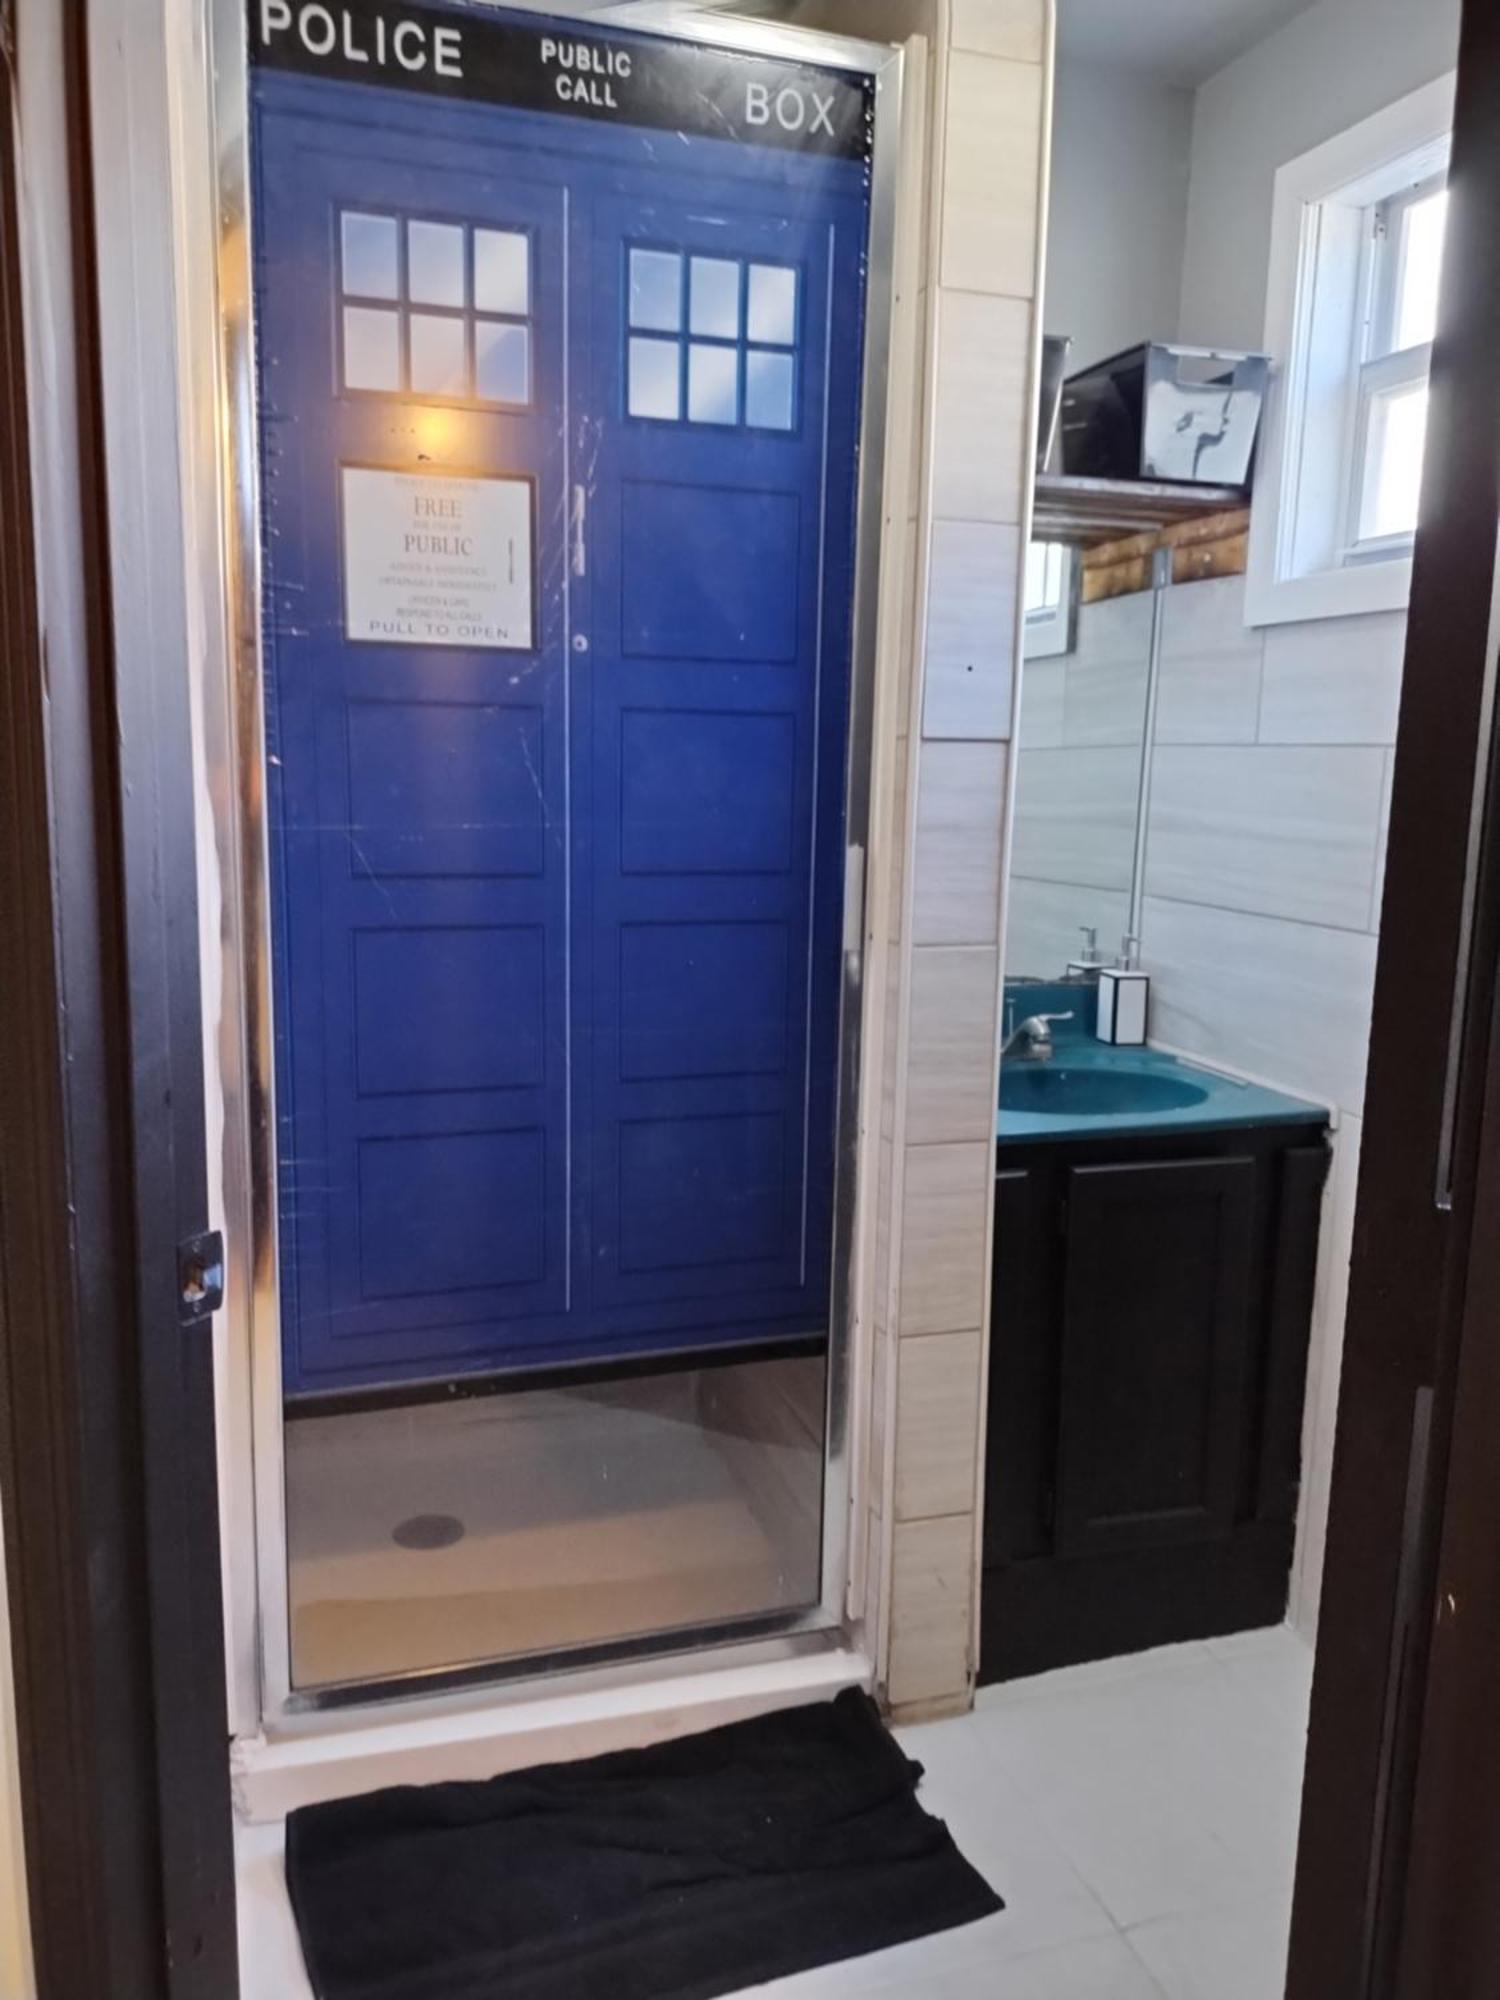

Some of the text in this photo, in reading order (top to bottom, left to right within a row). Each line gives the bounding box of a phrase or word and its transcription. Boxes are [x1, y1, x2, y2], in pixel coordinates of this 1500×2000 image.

[260, 0, 463, 78] POLICE
[540, 38, 632, 77] PUBLIC
[555, 73, 617, 108] CALL
[745, 82, 835, 137] BOX
[414, 496, 463, 519] FREE
[403, 533, 473, 556] PUBLIC
[369, 620, 509, 640] PULL TO OPEN
